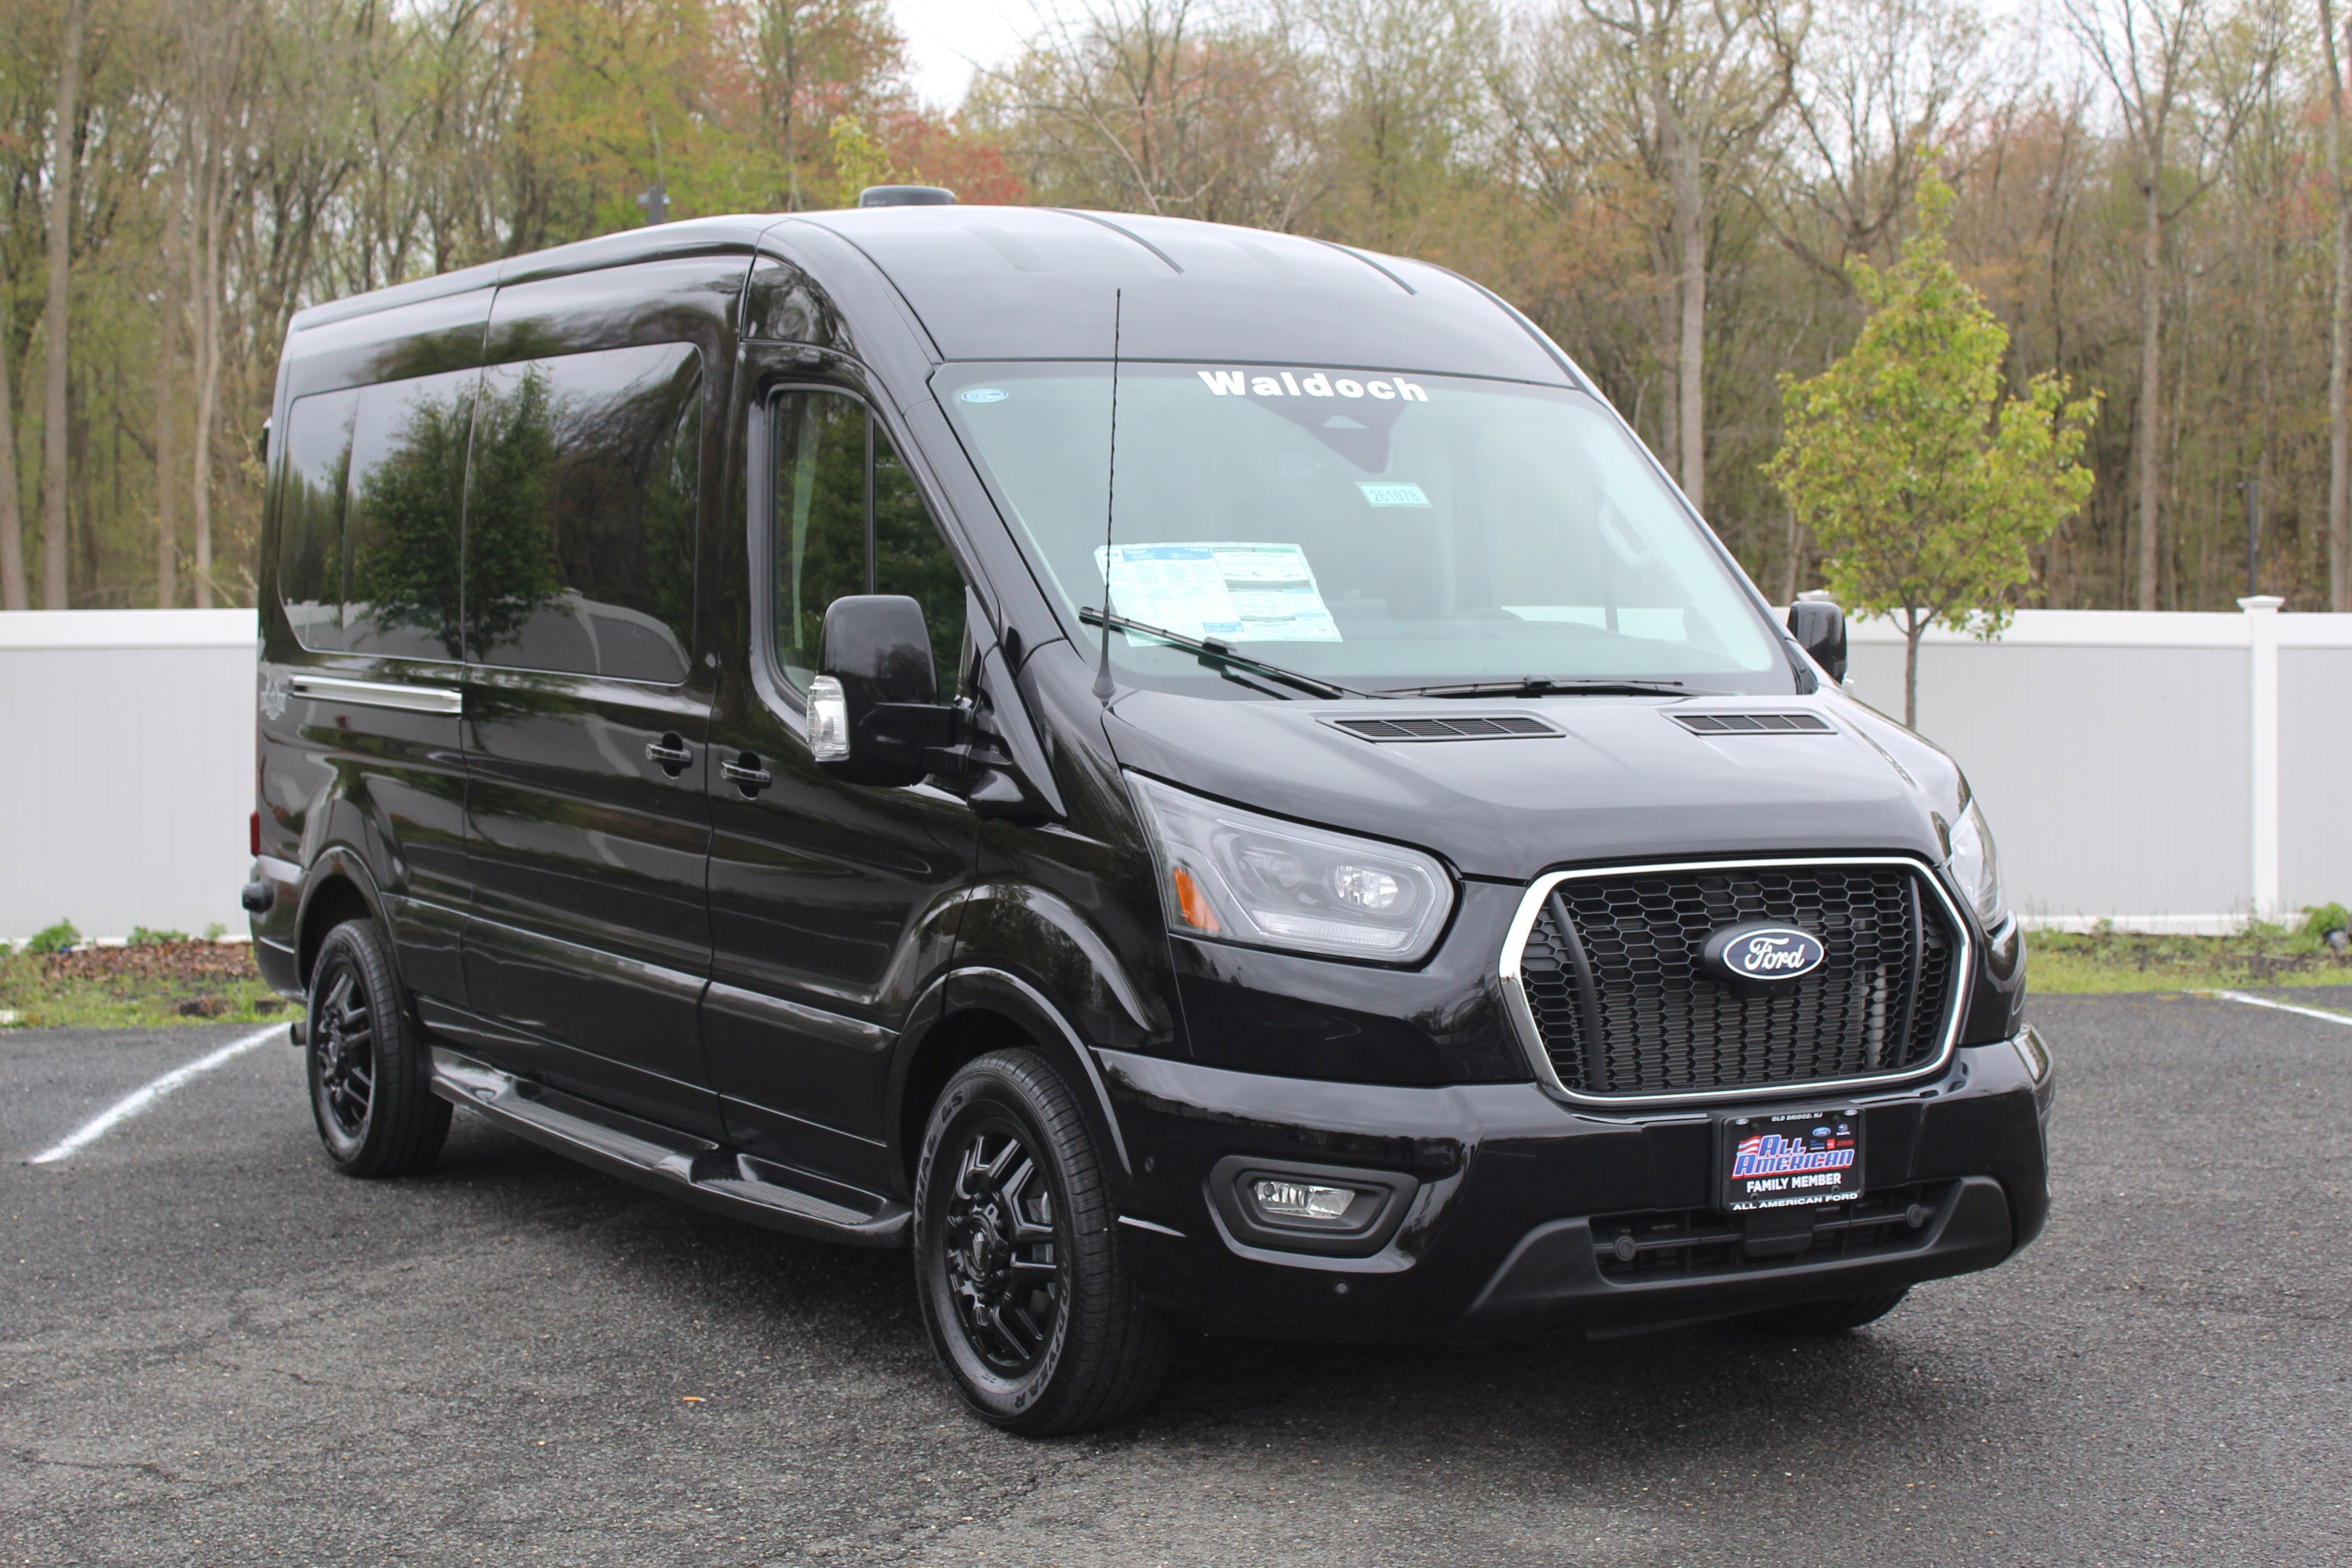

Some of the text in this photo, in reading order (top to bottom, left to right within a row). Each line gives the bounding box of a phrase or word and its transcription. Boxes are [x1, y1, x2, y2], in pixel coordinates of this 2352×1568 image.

[1197, 371, 1428, 402] Waldoch
[1744, 937, 1805, 970] Ford
[1746, 1173, 1842, 1192] FAMILY MEMBER
[1733, 1192, 1858, 1211] ALL AMERICAN FORD
